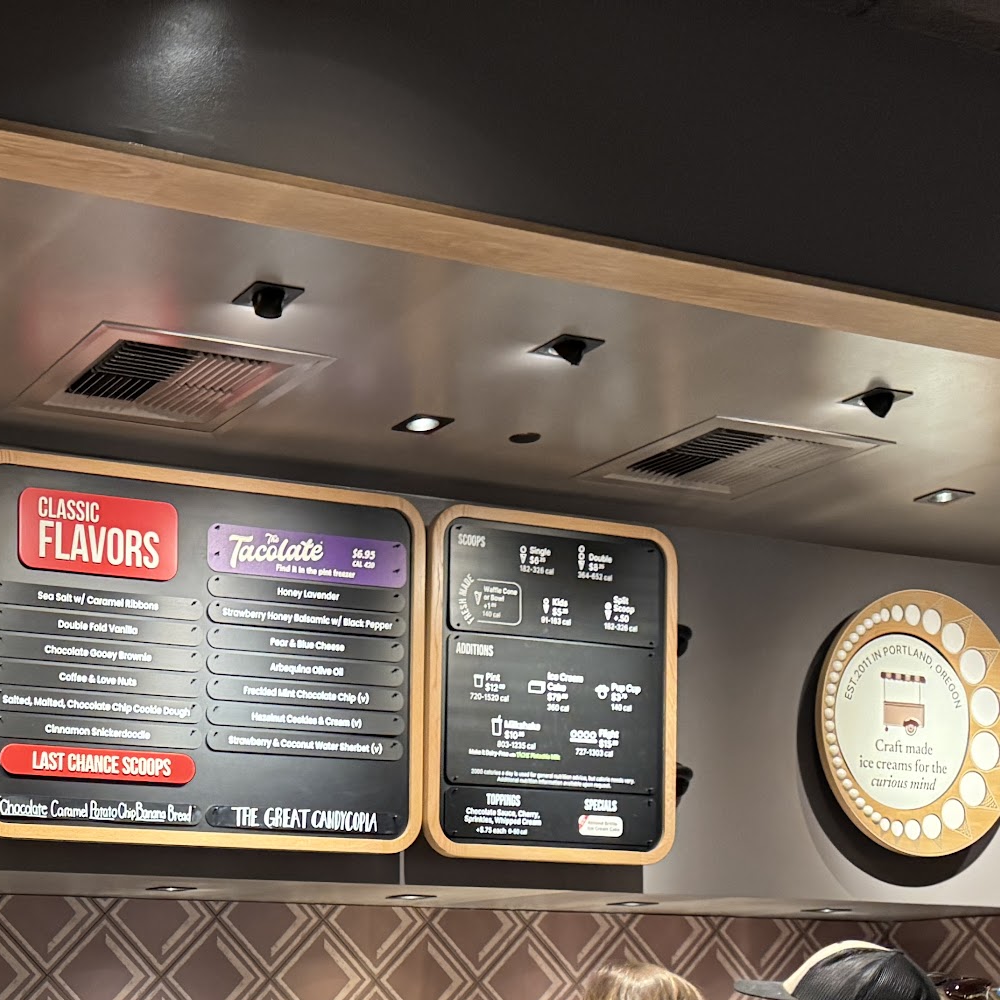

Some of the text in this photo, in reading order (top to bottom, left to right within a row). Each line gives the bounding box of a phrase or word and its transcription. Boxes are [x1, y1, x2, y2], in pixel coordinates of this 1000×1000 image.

[39, 496, 99, 523] CLASSIC
[39, 520, 160, 569] FLAVORS
[458, 534, 486, 548] SCOOPS
[229, 534, 376, 569] Tacolate $6.95
[530, 546, 551, 556] Single
[588, 553, 613, 563] Double
[276, 564, 291, 573] Find
[306, 567, 317, 575] the
[318, 568, 332, 577] pint
[459, 573, 474, 596] MADE
[484, 586, 502, 594] Waffle
[38, 591, 159, 611] Sea Salt w/ Caramel Ribbons
[277, 588, 339, 600] Honey Lavender
[458, 599, 475, 624] FRESH
[613, 604, 635, 615] Scoop
[58, 620, 138, 634] Double Fold Vanilla
[222, 608, 392, 631] Strawberry Honey Balsamic w/ Black Pepper
[270, 638, 345, 651] Pear & Blue Cheese
[456, 642, 494, 656] ADDITIONS
[44, 645, 152, 662] Chocolate Gooey Brownie
[270, 663, 344, 676] Arbequina Olive Oil
[485, 672, 500, 682] Pint
[854, 657, 872, 678] 2011
[872, 650, 882, 662] IN
[883, 645, 933, 668] PORTLAND,
[935, 664, 962, 708] OREGON
[59, 672, 137, 686] Coffee & Love Nuts
[243, 686, 369, 704] Freckled Mint Chocolate Chip (v)
[2, 695, 190, 718] Salted, Malted, Chocolate Chip Cookie Dough
[251, 712, 285, 723] Hazelnut
[286, 714, 317, 724] Cookies
[325, 717, 350, 727] Cream
[351, 718, 362, 728] (v)
[45, 724, 150, 739] Cinnamon Snickerdoodle
[228, 736, 272, 748] Strawberry
[281, 739, 314, 750] Coconut
[315, 741, 338, 751] Water
[339, 742, 370, 753] Sherbet
[371, 744, 382, 754] (v)
[875, 739, 933, 755] Craft made
[32, 751, 171, 777] LAST CHANCE SCOOPS
[860, 755, 947, 774] ice creams for the
[871, 775, 936, 790] curious mind
[486, 793, 521, 806] TOPPINGS
[584, 798, 617, 812] SPECIALS
[0, 799, 192, 823] Chocolate Caramel Potato Chip Banana Bread
[466, 807, 496, 816] Chocolate
[518, 810, 540, 819] Cherry,
[231, 807, 378, 832] THE GREAT CANDYCOPIA
[464, 815, 542, 826] Sprinkles, Whipped Cream
